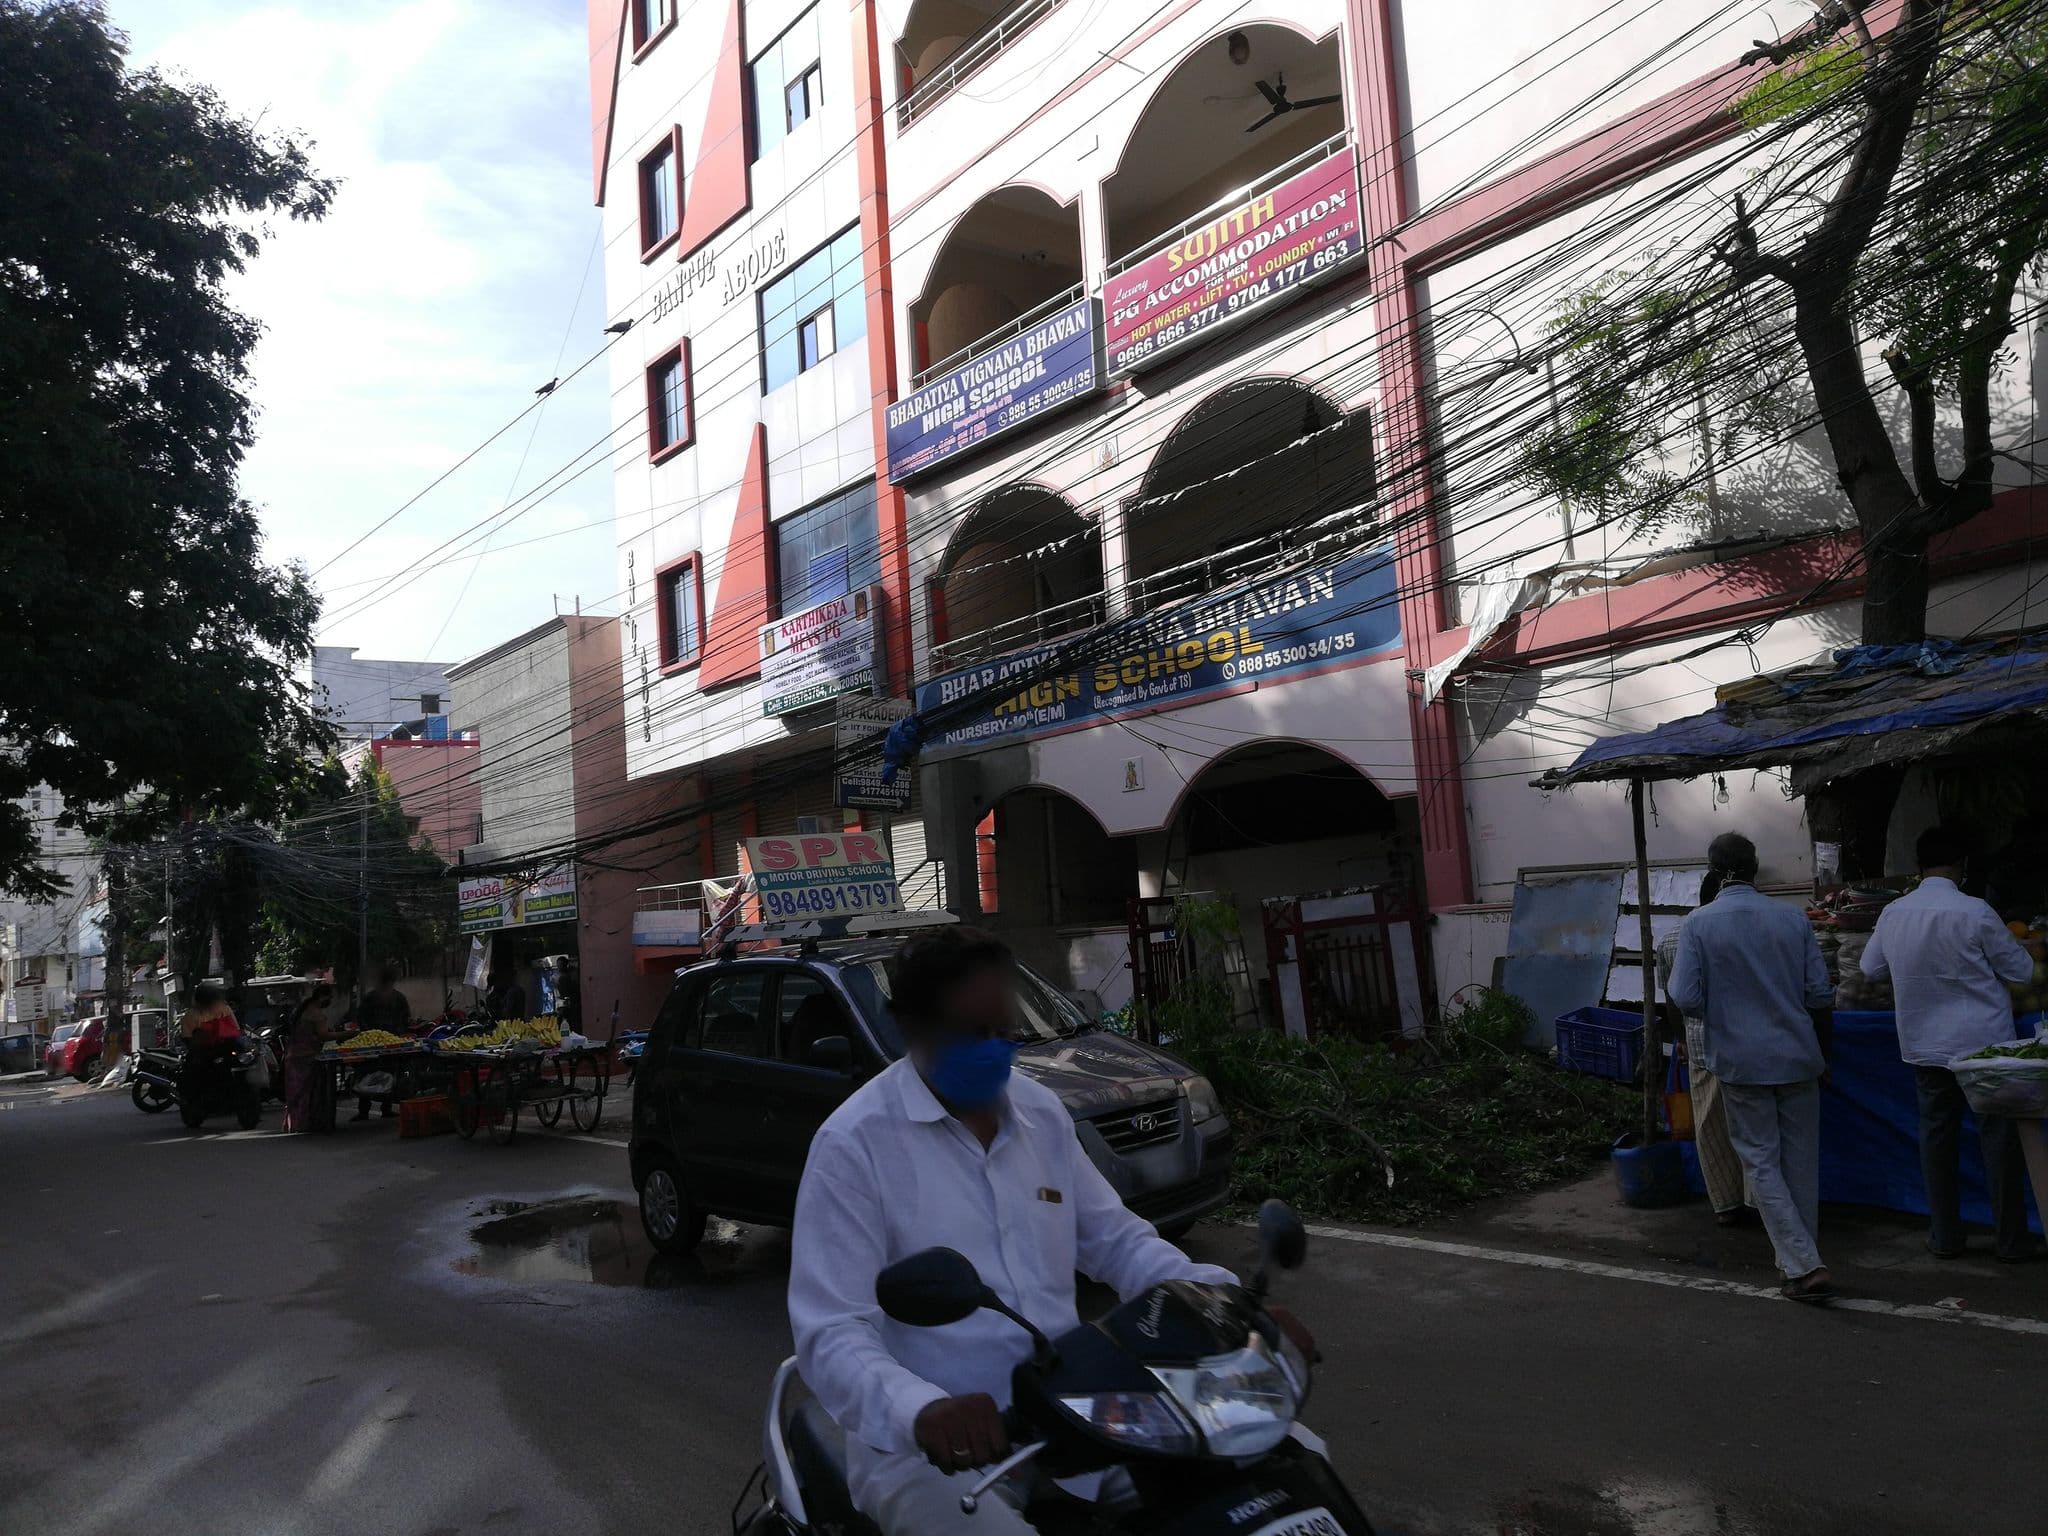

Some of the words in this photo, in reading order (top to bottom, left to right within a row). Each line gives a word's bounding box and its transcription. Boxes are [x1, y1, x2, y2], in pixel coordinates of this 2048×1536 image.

[1112, 301, 1139, 328] PG
[1144, 188, 1347, 311] ACCOMMODATION
[1167, 194, 1275, 273] SUJITH
[723, 227, 785, 307] ABODE
[1112, 279, 1150, 306] Luxury
[1131, 322, 1153, 343] HOT
[1154, 303, 1191, 330] WATER
[1200, 286, 1223, 307] LIFT
[1233, 274, 1249, 290] TV
[1257, 237, 1317, 277] LOUNDRY
[1204, 272, 1225, 290] FOR
[1226, 260, 1249, 280] MEN
[1116, 337, 1153, 368] 9666
[1156, 322, 1186, 347] 666
[1228, 282, 1271, 312] 9704
[1275, 262, 1308, 288] 177
[1313, 239, 1349, 270] 663
[890, 381, 960, 429] BHARATIYA
[960, 348, 1022, 391] VIGNANA
[1025, 307, 1087, 358] BHAVAN
[922, 395, 967, 435] HIGH
[968, 354, 1047, 410] SCHOOL
[1008, 405, 1027, 423] 888
[1028, 394, 1041, 413] 55
[1042, 369, 1092, 407] 30034/35
[781, 599, 848, 639] KARTHIKEYA
[1192, 569, 1335, 636] BHAVAN
[789, 627, 821, 655] MENS
[825, 619, 842, 645] PG
[994, 671, 1081, 718] HIGH
[1093, 626, 1264, 693] SCHOOL
[1094, 689, 1137, 710] (Recognised
[1137, 686, 1149, 704] By
[1149, 681, 1170, 697] Govt
[1179, 671, 1192, 689] TS)
[1238, 655, 1263, 675] 888
[1264, 650, 1282, 668] 55
[757, 834, 887, 870] SPR
[769, 870, 804, 884] MOTOR
[806, 867, 846, 881] DRIVING
[847, 864, 885, 877] SCHOOL
[766, 881, 898, 918] 9848913797
